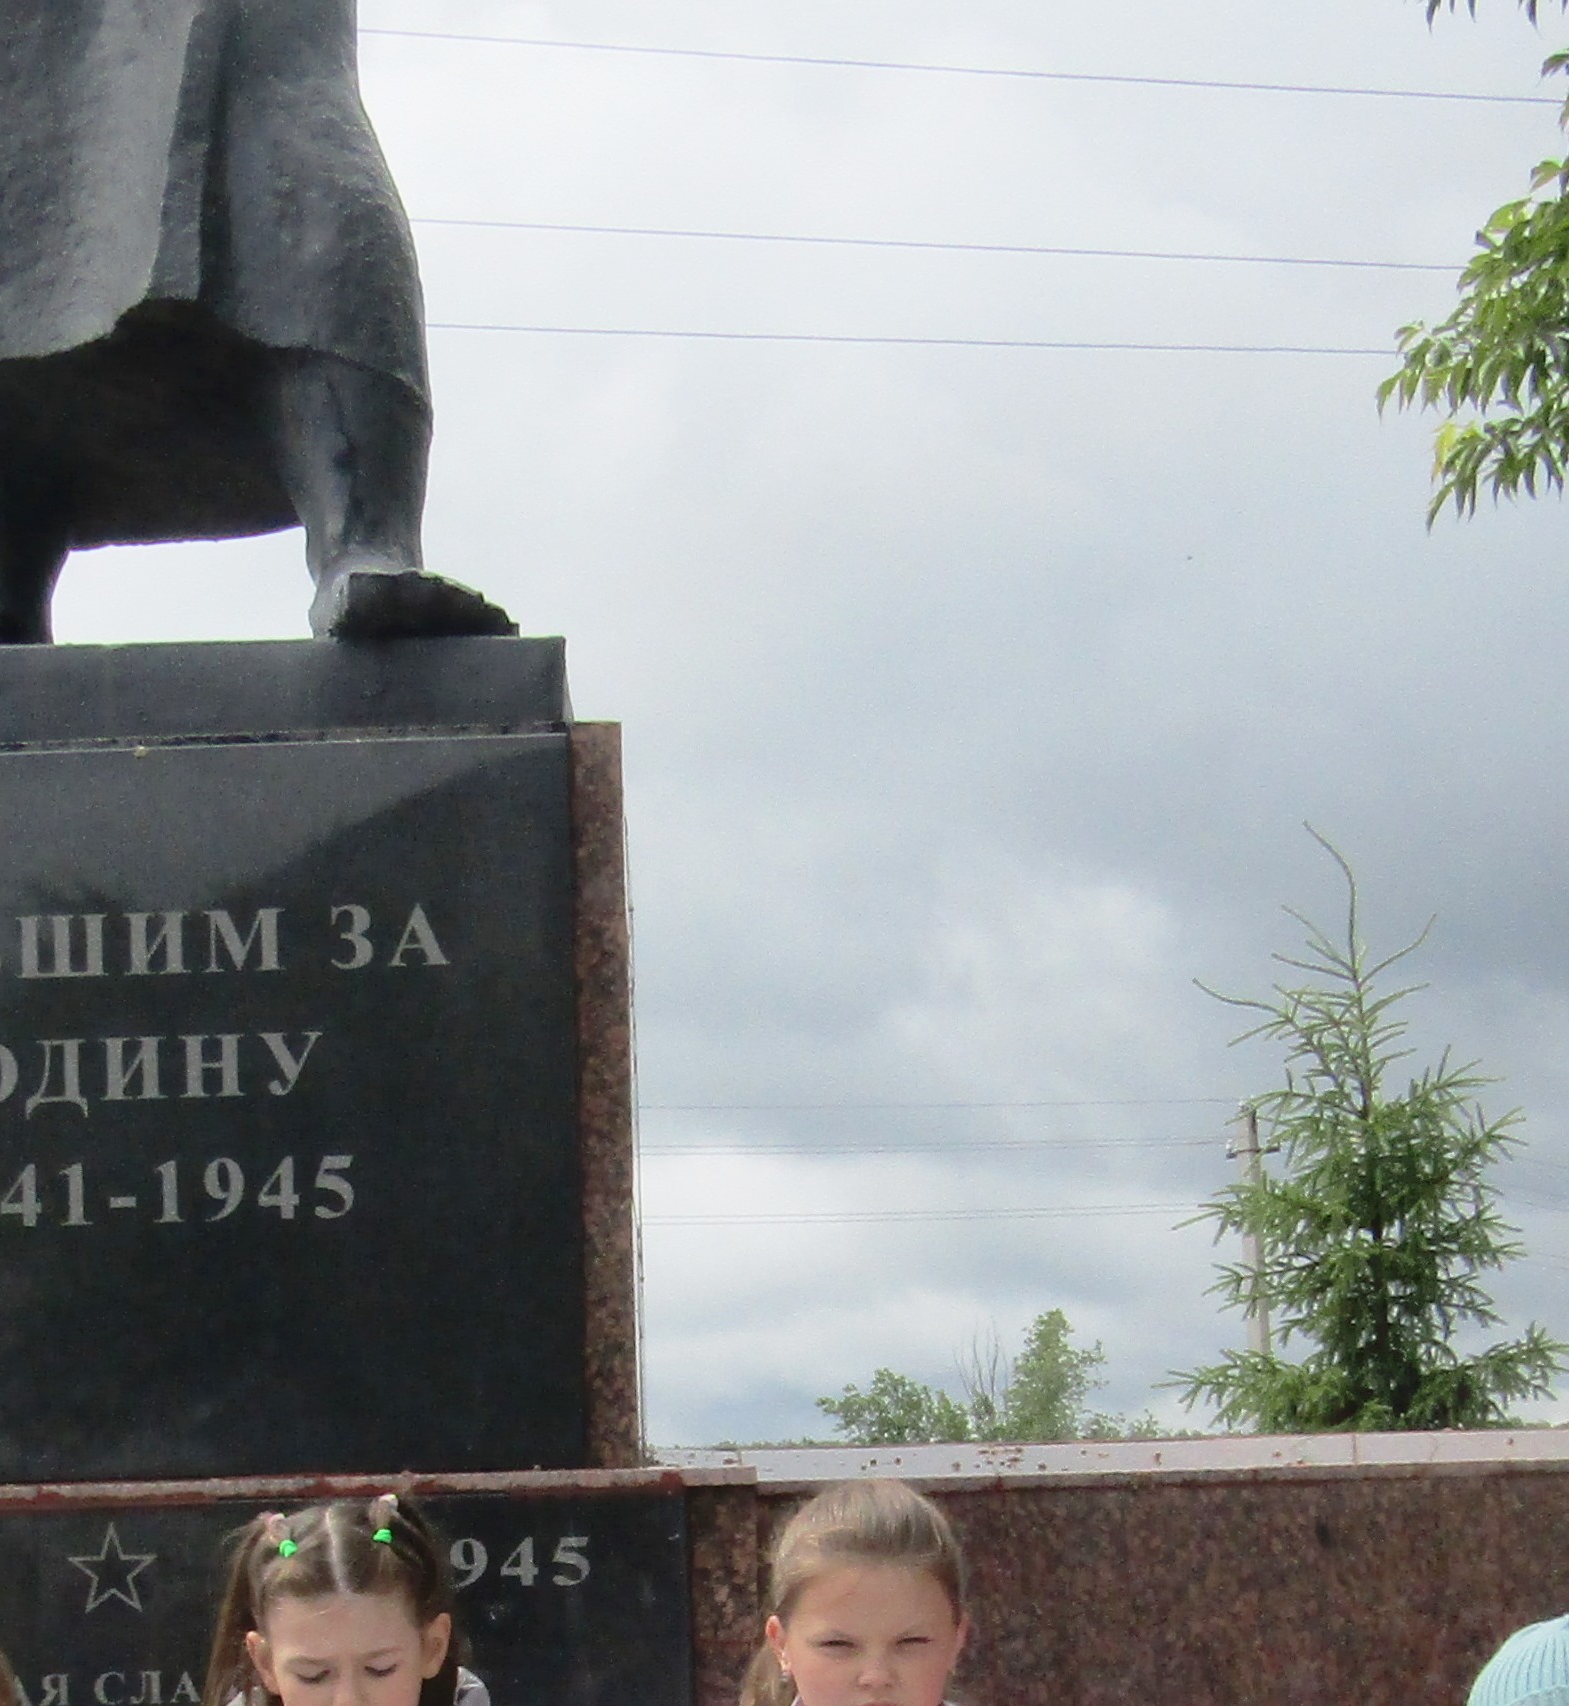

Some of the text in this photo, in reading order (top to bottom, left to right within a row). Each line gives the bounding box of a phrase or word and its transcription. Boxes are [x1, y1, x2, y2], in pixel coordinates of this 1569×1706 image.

[331, 902, 451, 970] ЗА
[449, 1536, 591, 1591] 945
[93, 1669, 202, 1706] СЛА
